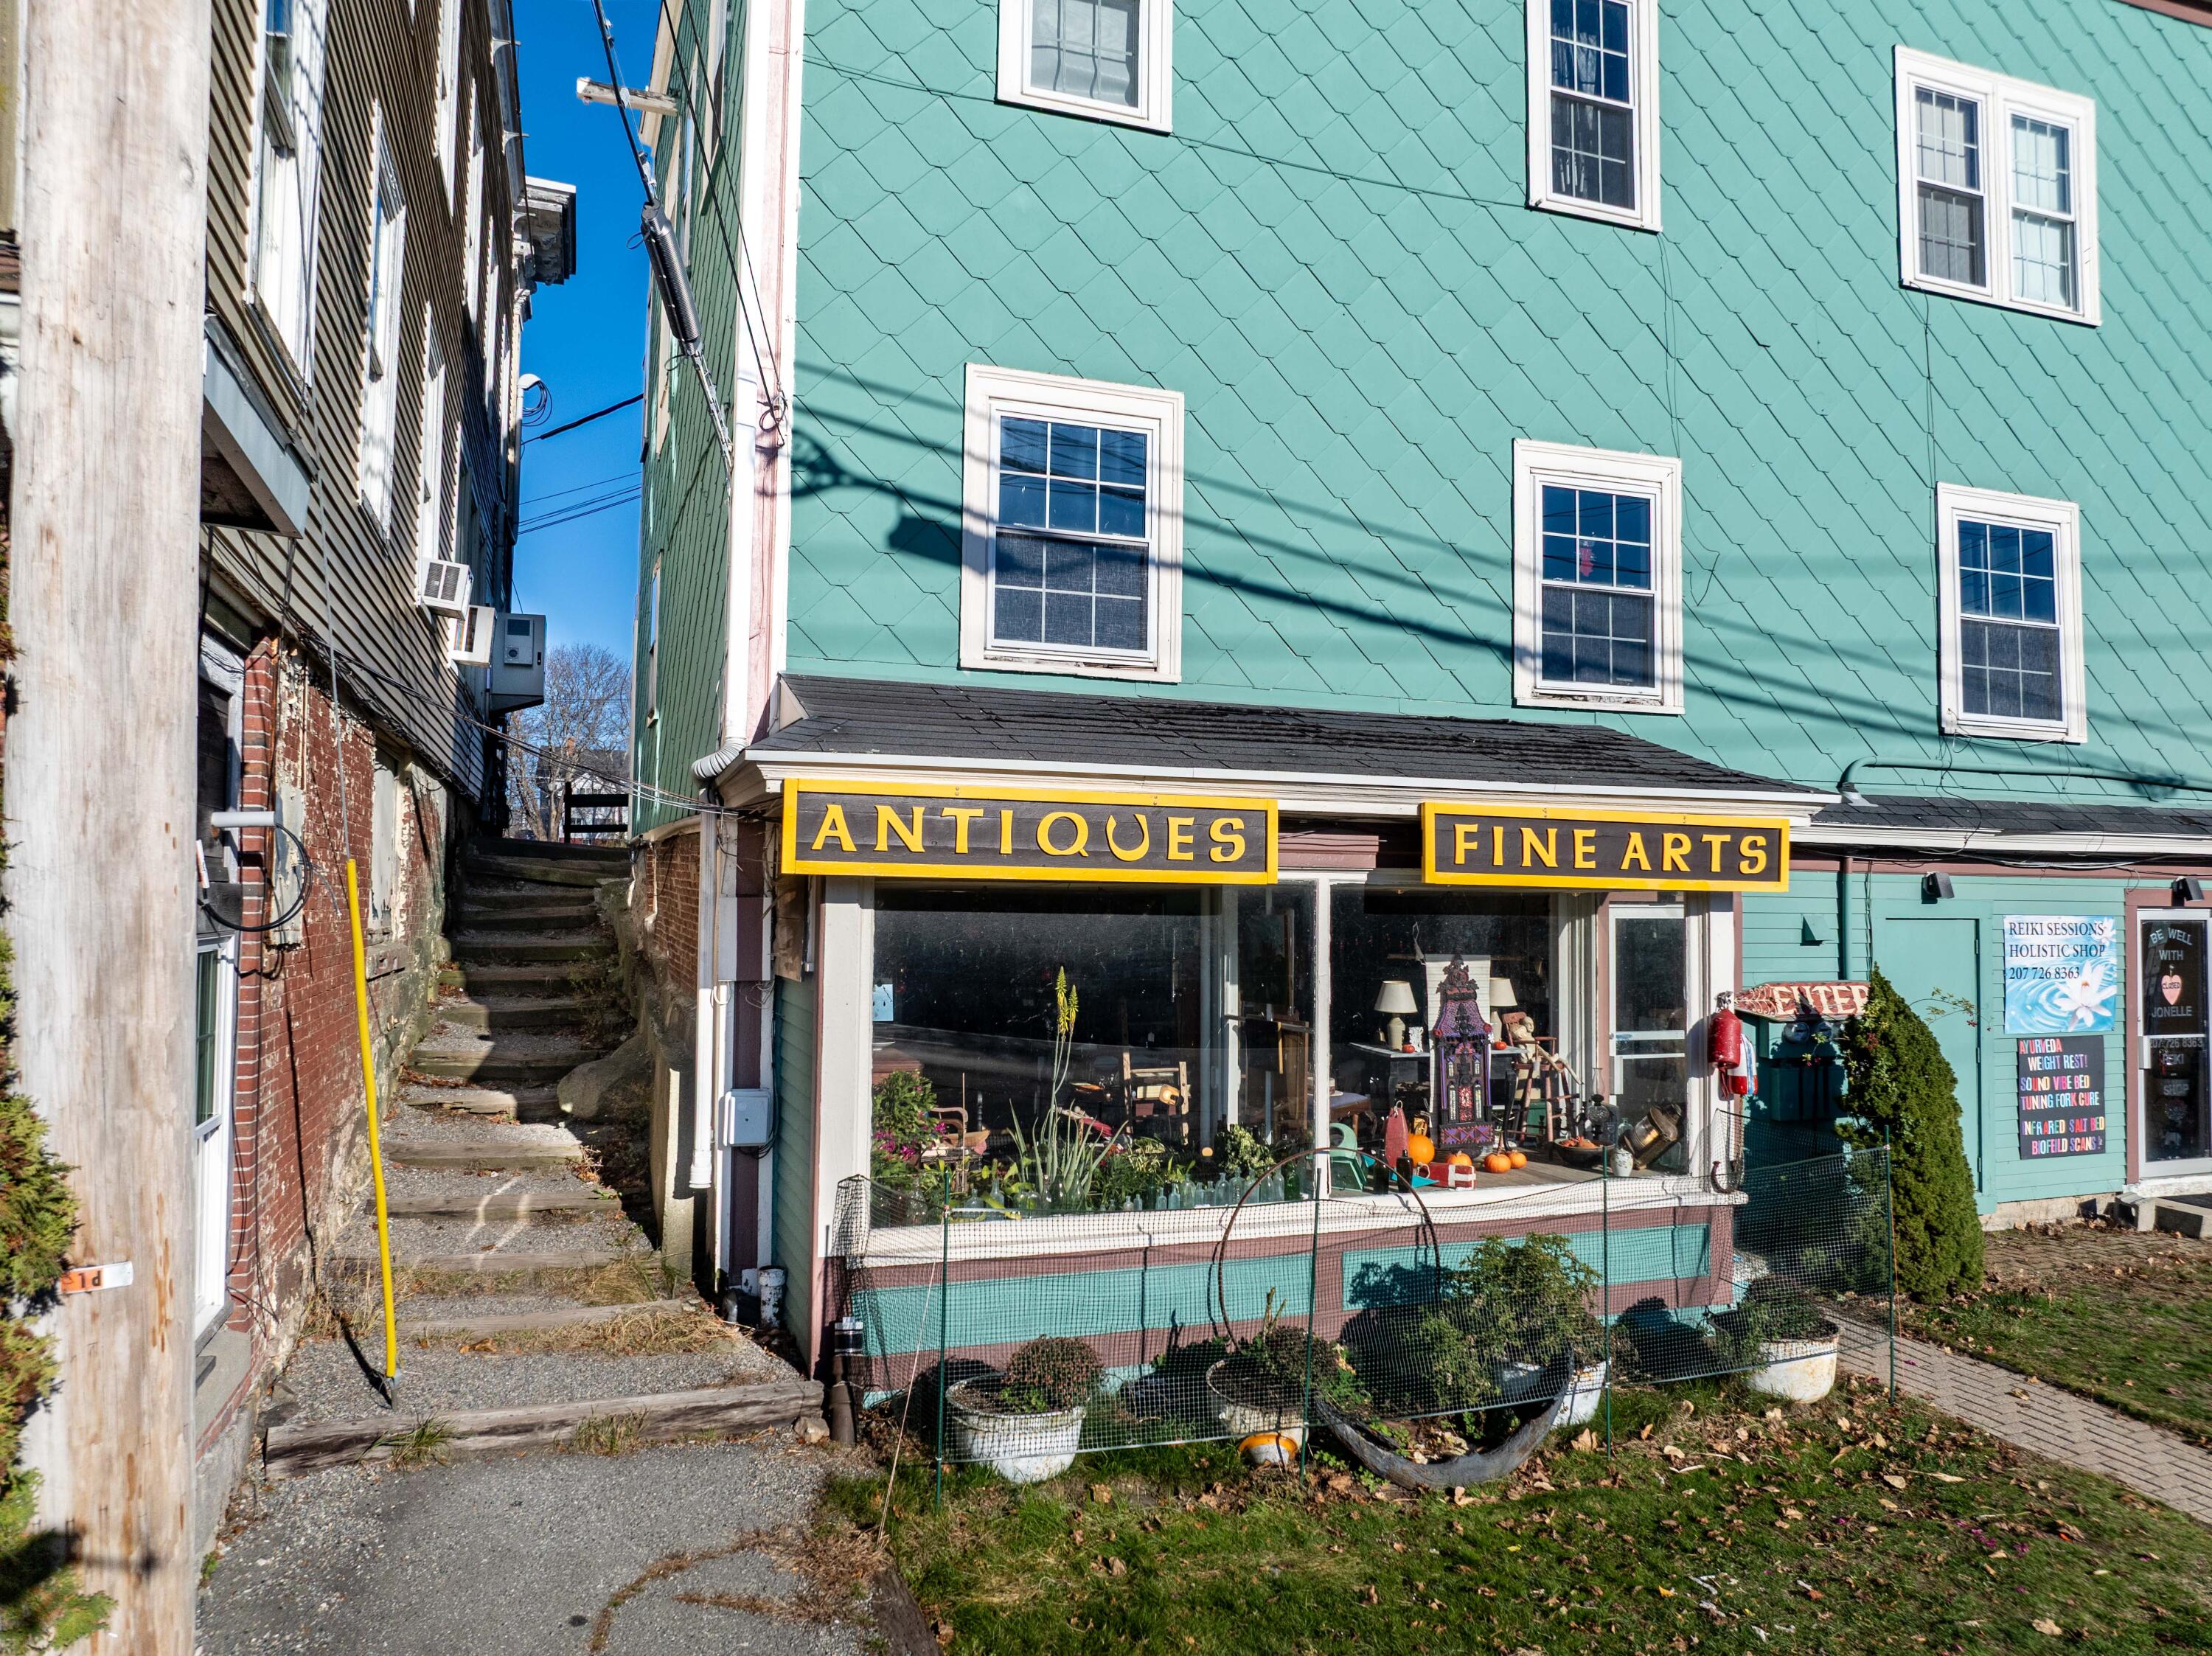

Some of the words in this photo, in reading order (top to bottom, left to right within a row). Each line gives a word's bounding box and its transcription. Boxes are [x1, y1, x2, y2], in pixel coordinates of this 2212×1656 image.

[811, 804, 1247, 863] ANTIQUES
[1454, 823, 1596, 869] FINE
[1621, 832, 1767, 874] ARTS
[2008, 922, 2044, 936] REIKI
[2047, 922, 2105, 936] SESSIONS
[2150, 928, 2165, 944] BE
[2168, 927, 2193, 946] WELL
[2009, 944, 2070, 958] HOLISTIC
[2073, 944, 2106, 958] SHOP
[2159, 949, 2184, 961] WITH
[2008, 967, 2028, 980] 207
[2032, 967, 2051, 980] 726
[2054, 966, 2080, 980] 8363
[2162, 981, 2180, 989] CLOSED
[2152, 1006, 2193, 1018] JONELLE
[2019, 1037, 2063, 1054] AYURVEDA
[2182, 1037, 2204, 1048] 8363
[2028, 1055, 2061, 1071] WEIGHT
[2063, 1054, 2089, 1069] REST!
[2020, 1076, 2051, 1092] SOUND
[2053, 1075, 2073, 1090] VIBE
[2074, 1074, 2090, 1090] BED
[2163, 1084, 2189, 1096] SHOP
[2021, 1094, 2053, 1110] TUNING
[2055, 1092, 2078, 1107] FORK
[2079, 1091, 2100, 1107] CURE
[2022, 1120, 2066, 1135] INFRARED
[2069, 1118, 2088, 1133] SALT
[2090, 1116, 2105, 1132] BED
[2031, 1138, 2068, 1155] BIOFEILD
